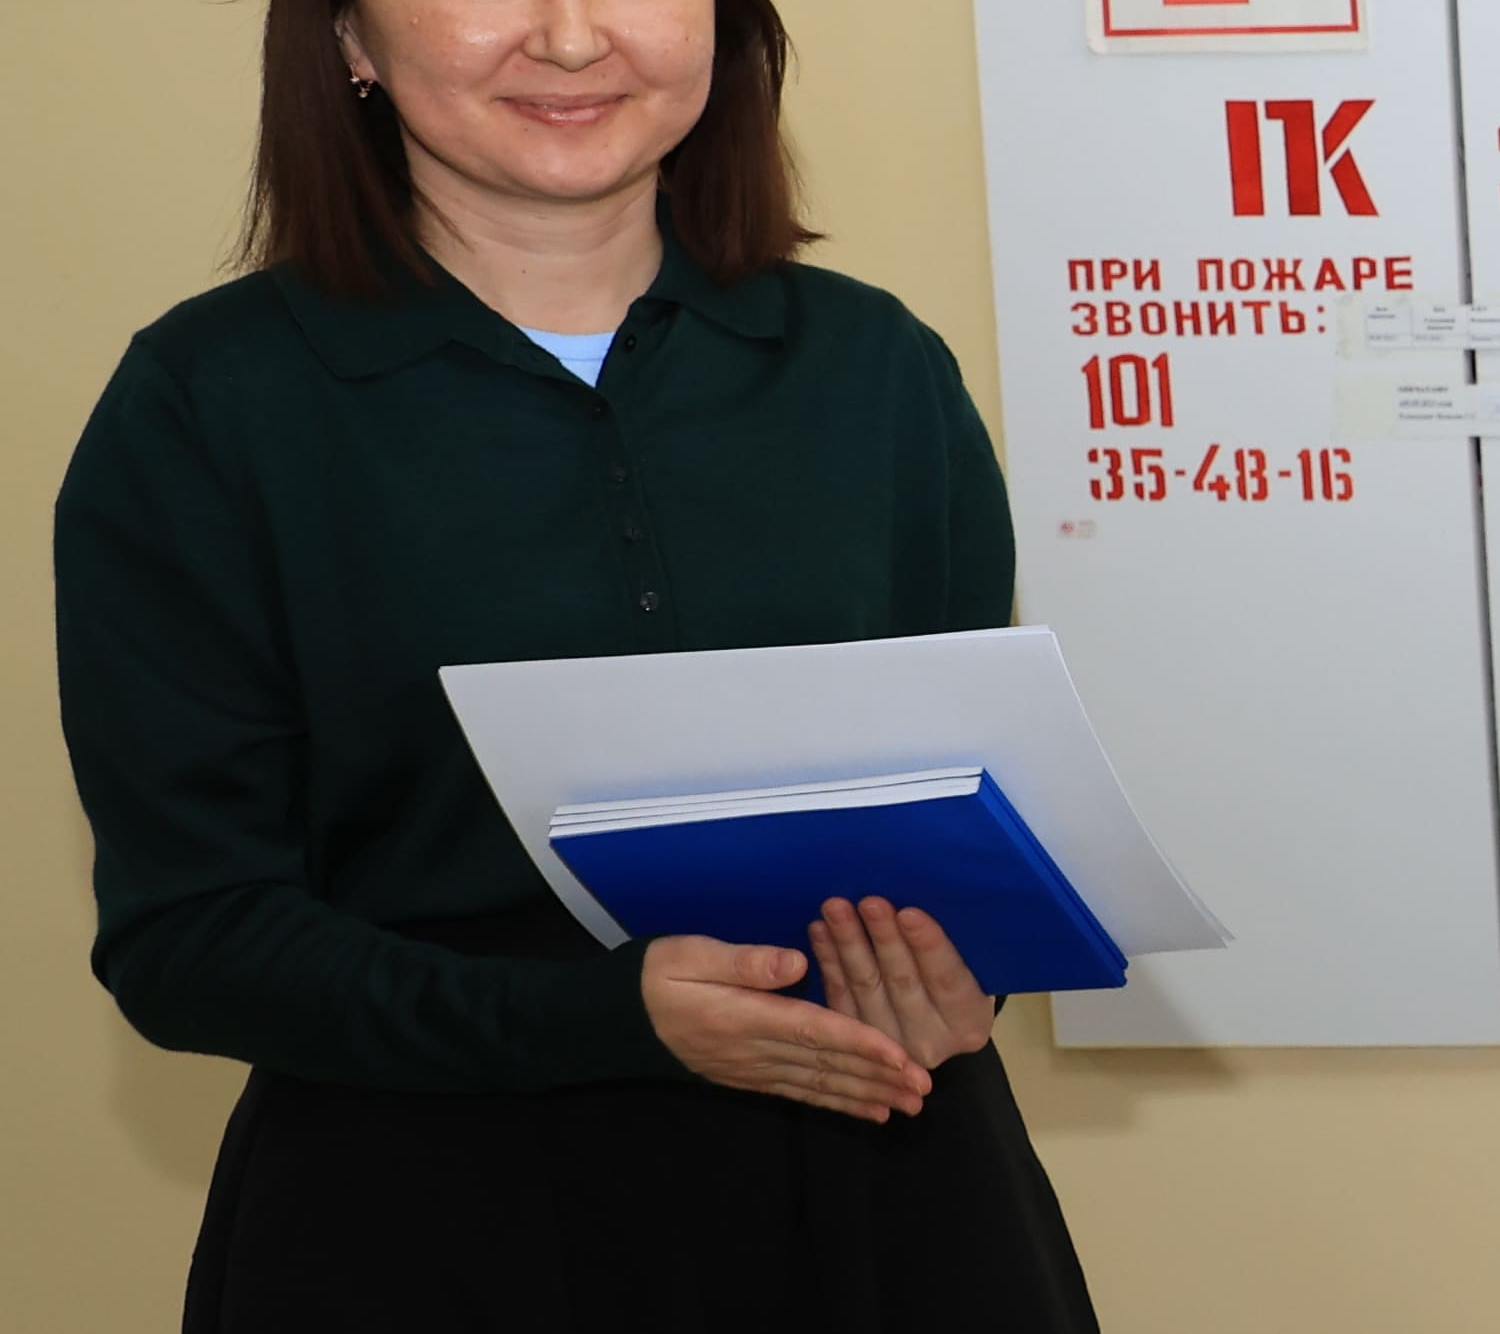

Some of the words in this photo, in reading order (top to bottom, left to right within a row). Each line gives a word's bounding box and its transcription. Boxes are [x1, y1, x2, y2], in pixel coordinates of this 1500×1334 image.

[1067, 257, 1162, 292] ПРИ
[1197, 255, 1414, 292] ПОЖАРЕ
[1071, 299, 1327, 338] ЗВОНИТЬ:
[1081, 352, 1175, 431] 101
[1087, 443, 1355, 502] 35-48-16
